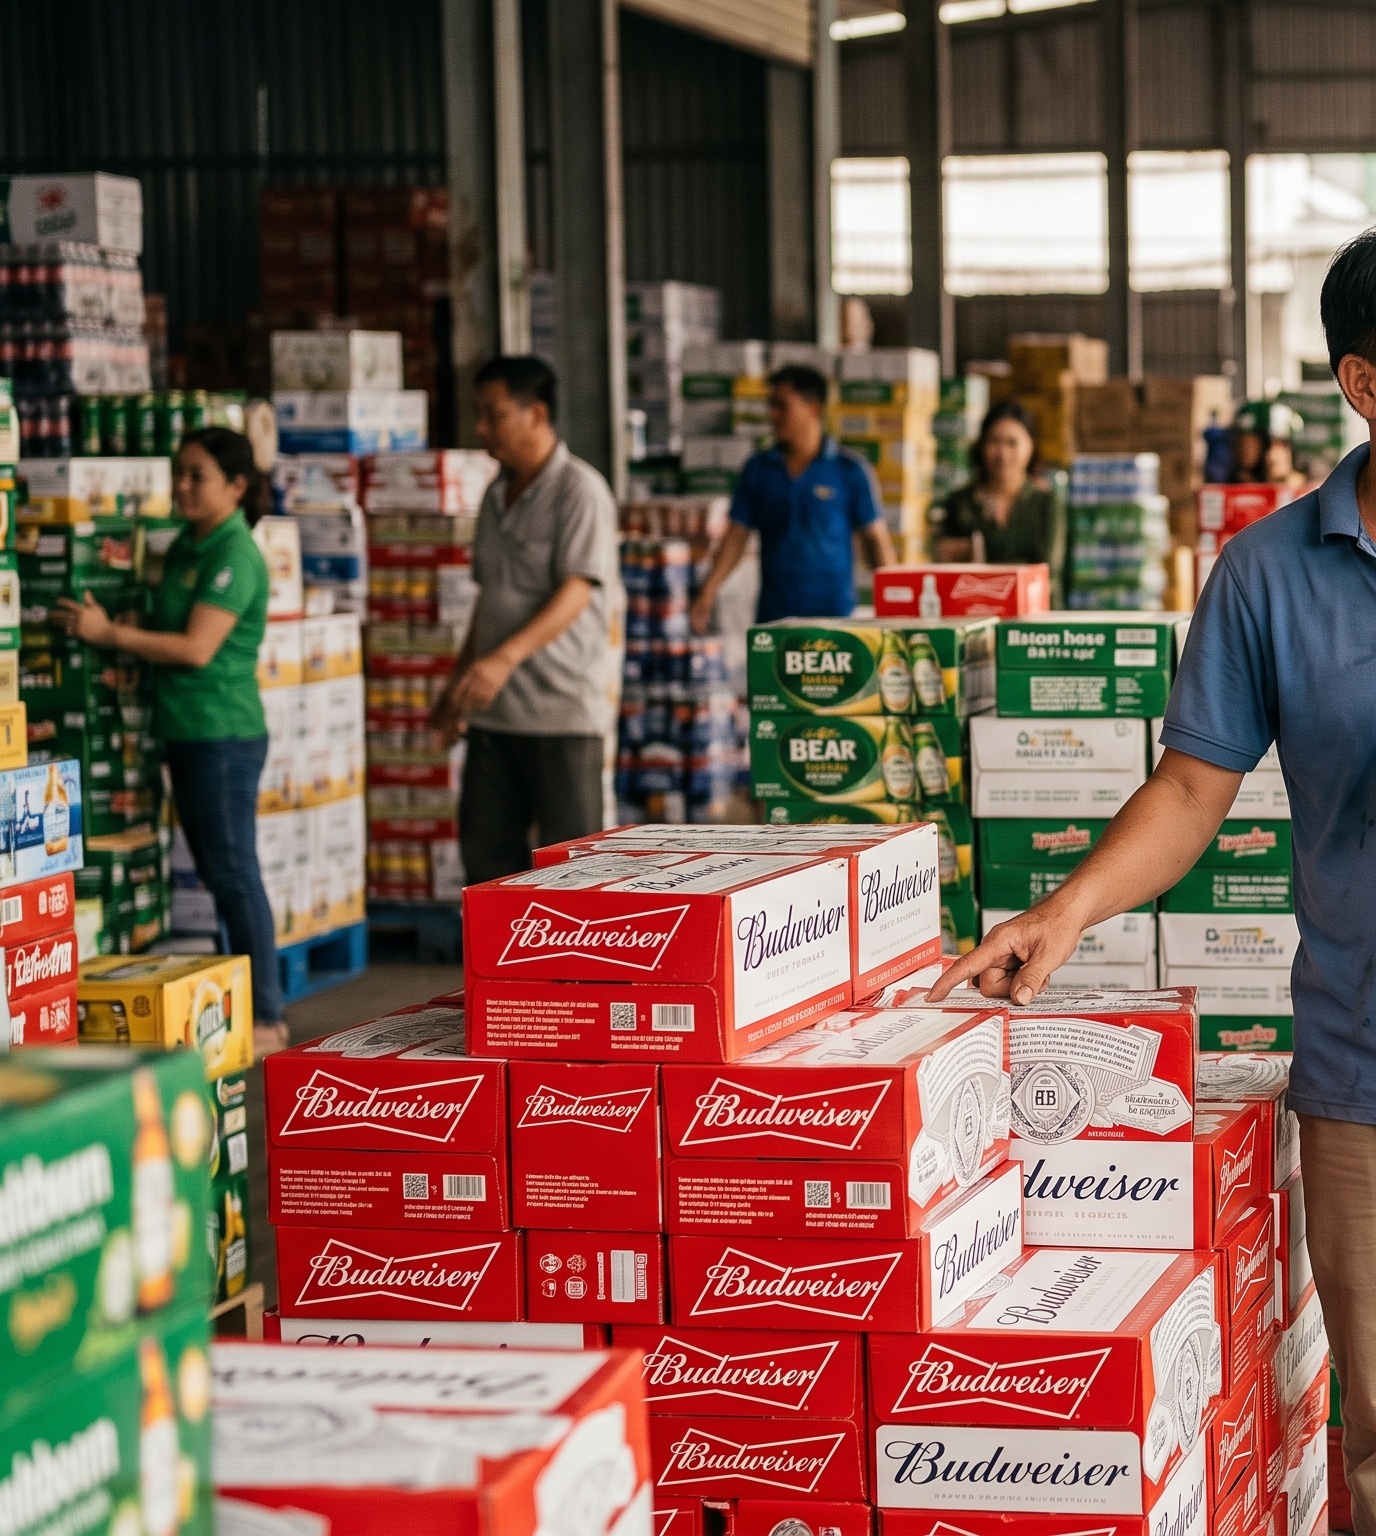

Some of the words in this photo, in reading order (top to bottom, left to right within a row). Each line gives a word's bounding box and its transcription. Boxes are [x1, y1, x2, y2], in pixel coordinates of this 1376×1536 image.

[1063, 629, 1106, 647] hose
[785, 651, 853, 675] BEAR
[789, 738, 857, 762] BEAR
[861, 861, 936, 924] Budweiser
[511, 917, 669, 949] Budweiser
[737, 899, 845, 972] Budweiser
[296, 1086, 463, 1120] Budweiser
[525, 1095, 638, 1119] Budweiser
[696, 1094, 872, 1127] Budweiser
[1023, 1158, 1180, 1202] dweiser
[934, 1207, 1019, 1300] Budweiser
[309, 1254, 481, 1289] Budweiser
[706, 1264, 880, 1298] Budweiser
[642, 1353, 818, 1387] Budweiser
[908, 1358, 1088, 1396] Budweiser
[670, 1441, 826, 1472] Budweiser
[884, 1440, 1131, 1487] Budweiser
